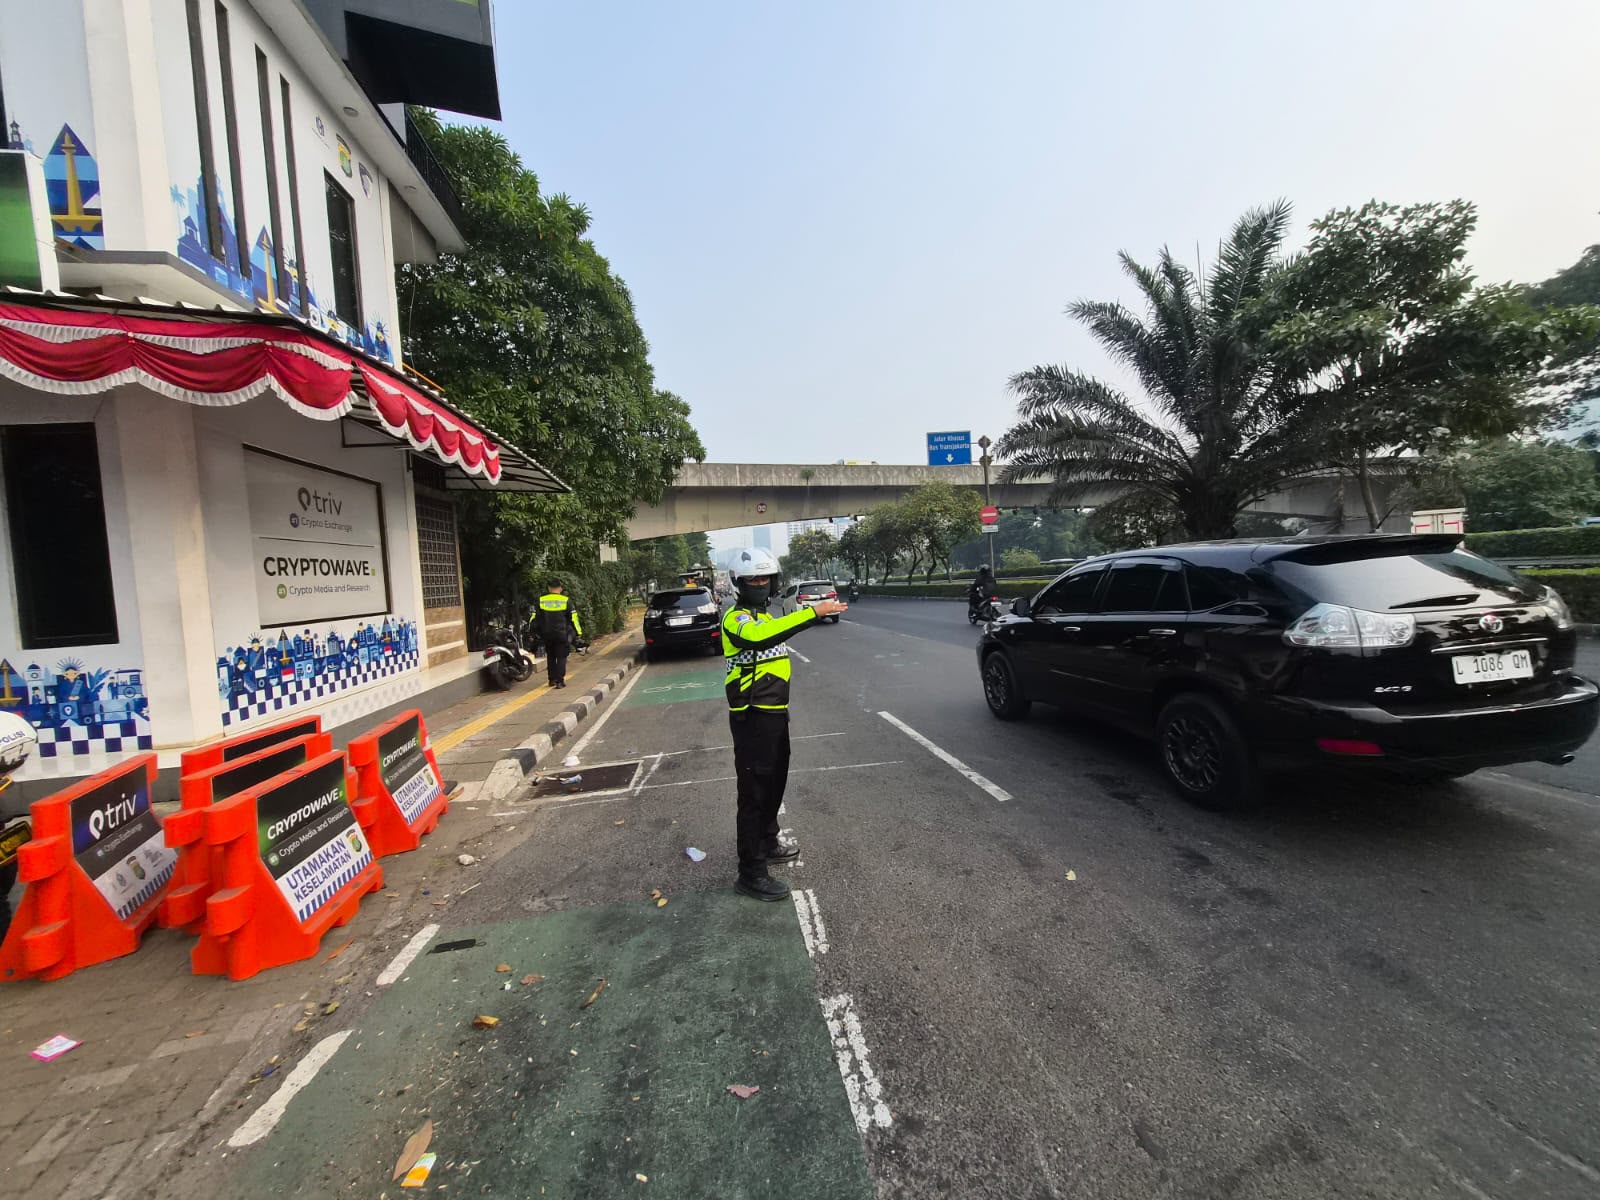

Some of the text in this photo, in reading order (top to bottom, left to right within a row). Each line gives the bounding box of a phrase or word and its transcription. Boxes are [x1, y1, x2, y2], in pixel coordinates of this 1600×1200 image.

[312, 489, 342, 515] triv
[301, 516, 323, 528] Crypto
[324, 520, 353, 533] Exchange
[289, 585, 313, 596] Crypto
[314, 584, 334, 594] Media
[334, 584, 346, 593] and
[346, 584, 371, 593] Research
[1473, 655, 1504, 674] 1086
[1513, 654, 1529, 669] QM
[0, 730, 26, 744] OLISI
[395, 773, 425, 804] UTAMAKAN
[104, 792, 137, 829] triv
[279, 838, 300, 857] Crypto
[299, 826, 318, 845] Media
[317, 820, 329, 836] and
[328, 807, 350, 824] Research
[286, 838, 347, 890] UTAMAKAN
[293, 851, 352, 902] KESELAMATAN
